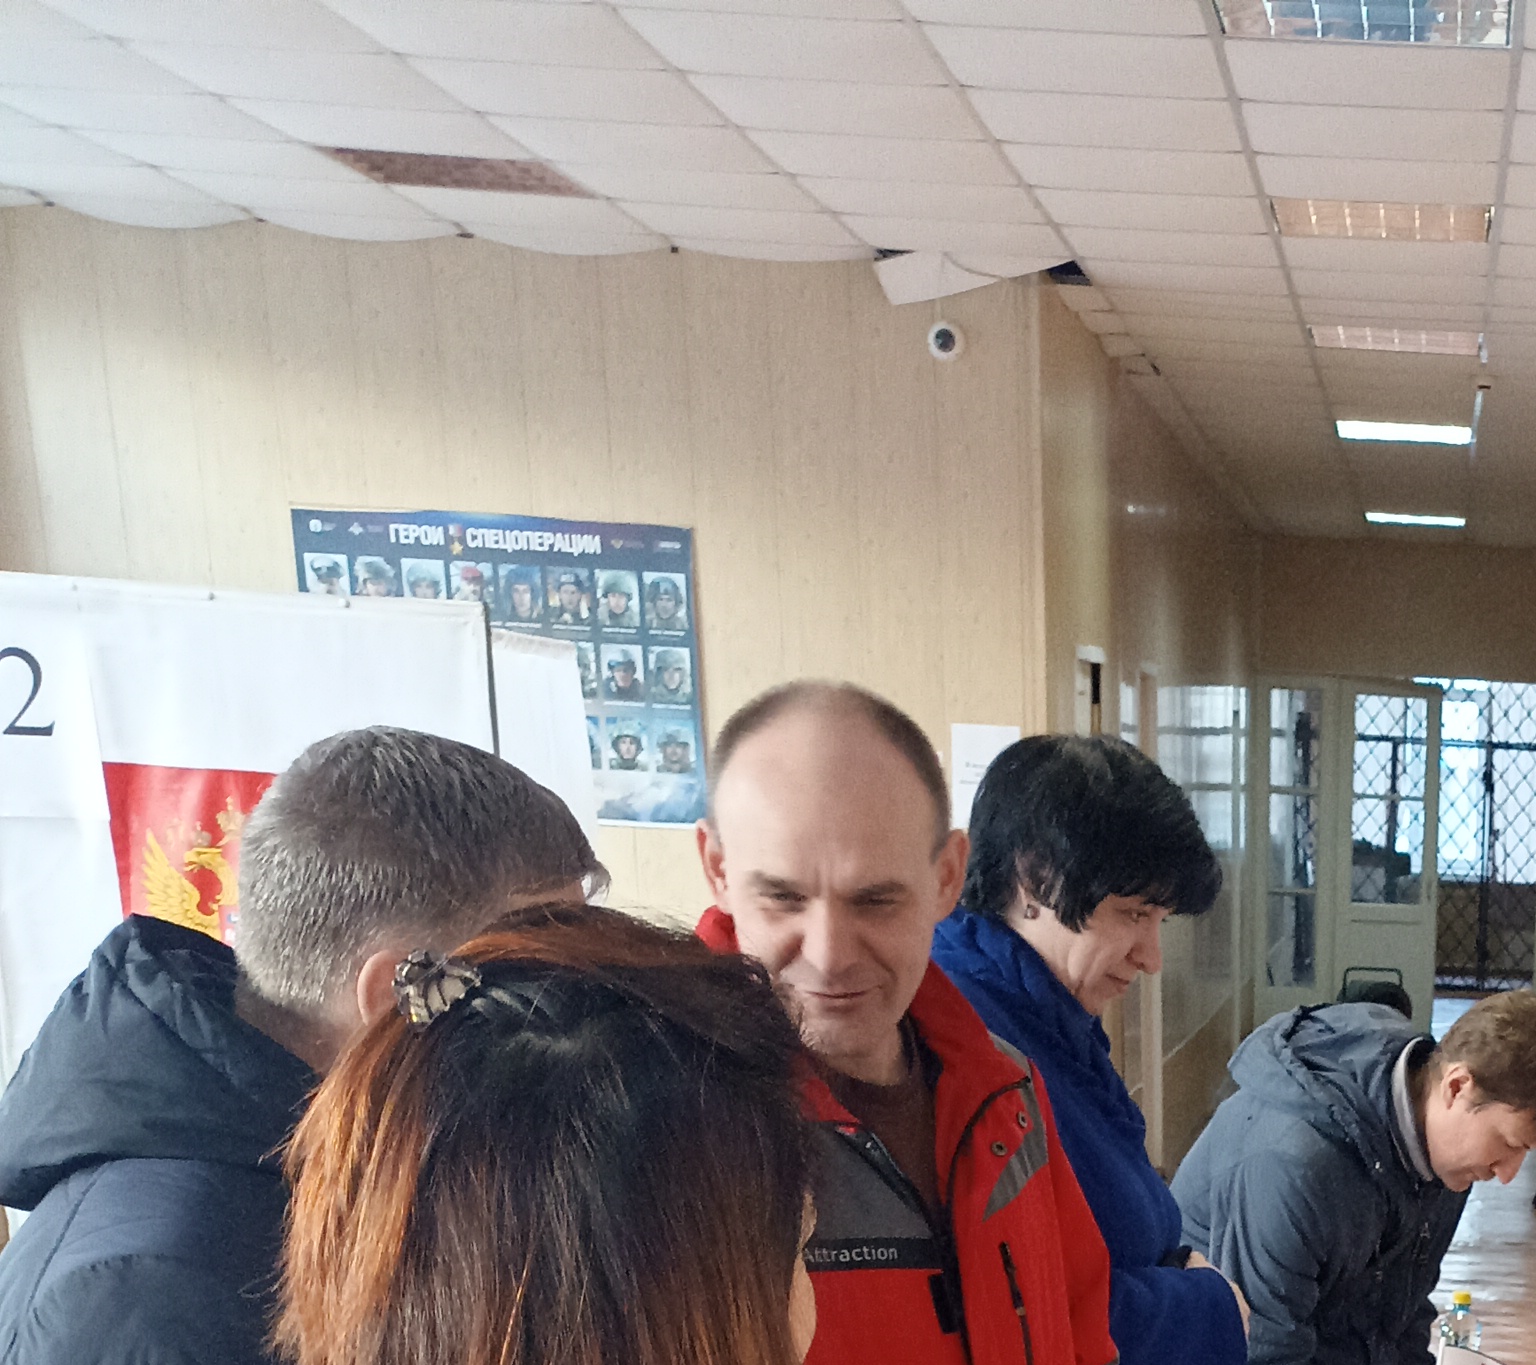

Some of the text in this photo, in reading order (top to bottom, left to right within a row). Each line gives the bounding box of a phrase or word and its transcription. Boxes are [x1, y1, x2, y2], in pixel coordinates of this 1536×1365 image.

[389, 523, 446, 546] ГЕРОИ
[465, 527, 602, 556] СПЕЦОПЕРАЦИИ
[0, 646, 55, 737] 2
[803, 1245, 898, 1263] Attraction
